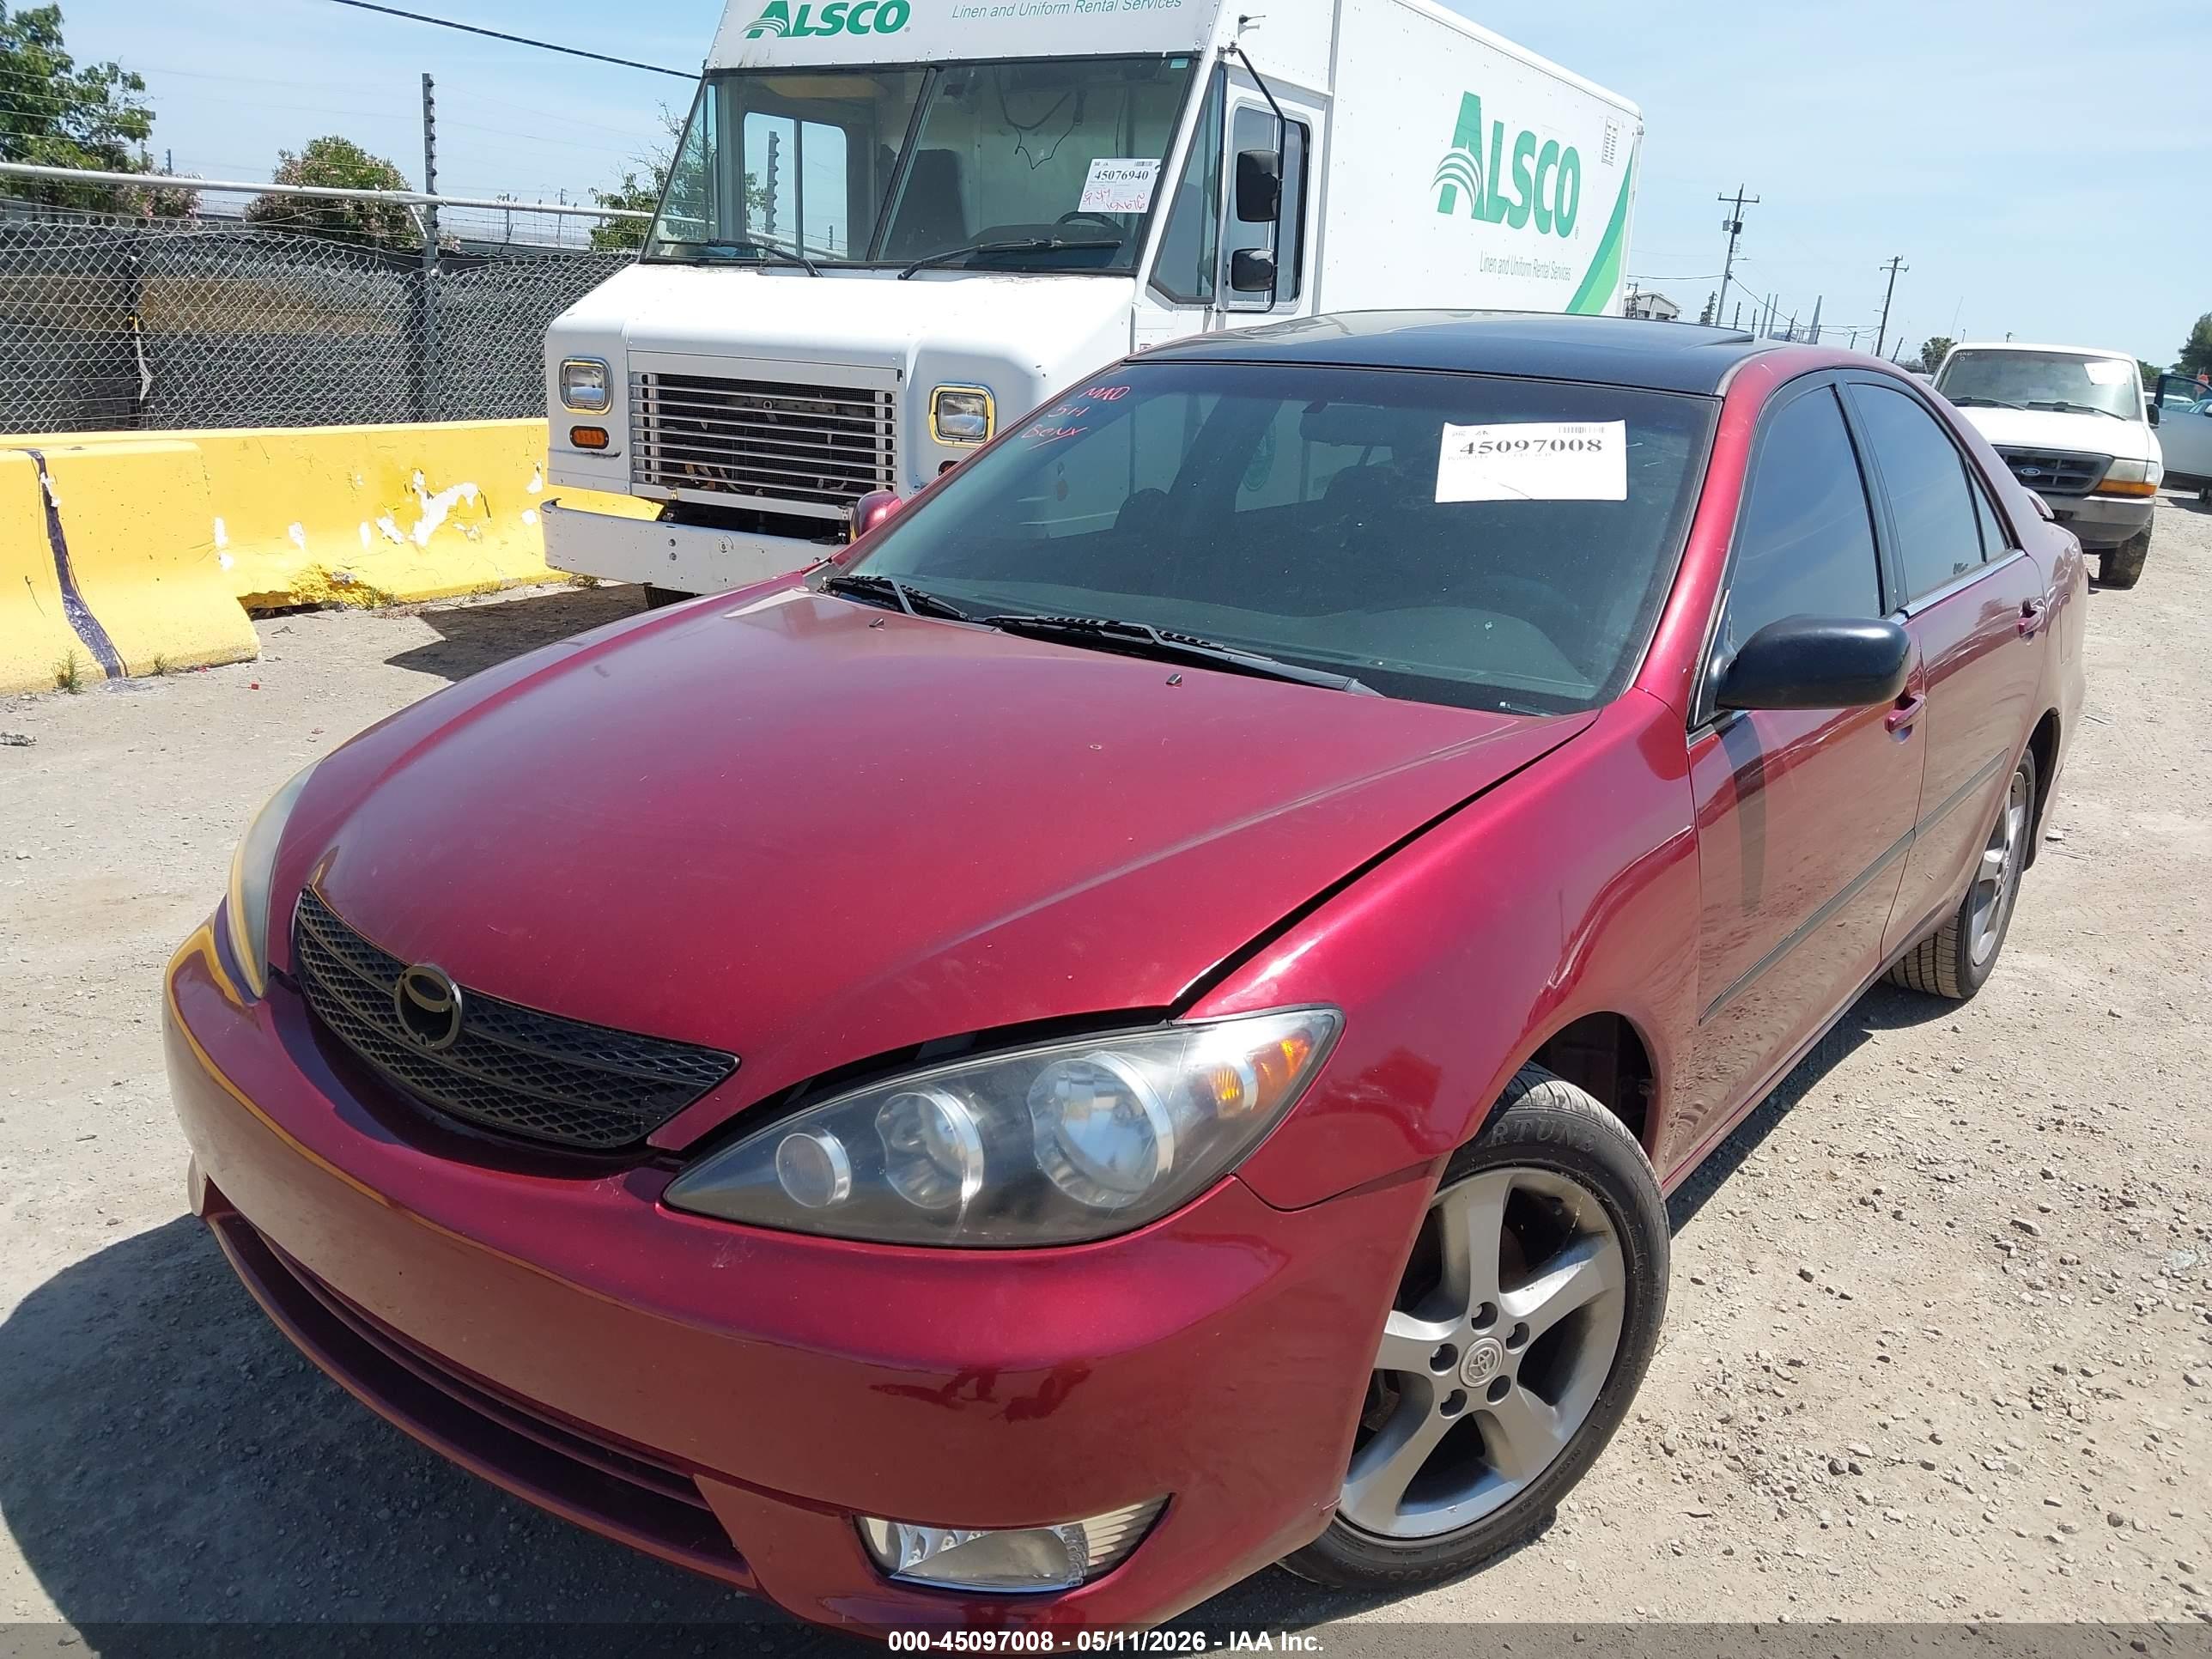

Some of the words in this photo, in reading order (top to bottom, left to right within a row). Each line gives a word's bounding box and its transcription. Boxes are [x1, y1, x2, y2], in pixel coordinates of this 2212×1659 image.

[741, 0, 910, 39] ALSCO
[951, 4, 987, 18] Linen
[990, 3, 1014, 17] and
[1018, 2, 1070, 16] Uniform
[1073, 0, 1116, 14] Rental
[1121, 0, 1182, 11] Services
[1094, 170, 1149, 180] 45076940
[1430, 90, 1581, 238] ALSCO
[1480, 249, 1497, 273] Linen
[1498, 253, 1510, 275] and
[1510, 253, 1532, 276] Uniform
[1533, 258, 1551, 279] Rental
[1551, 259, 1571, 282] Services
[1459, 439, 1603, 455] 45097008
